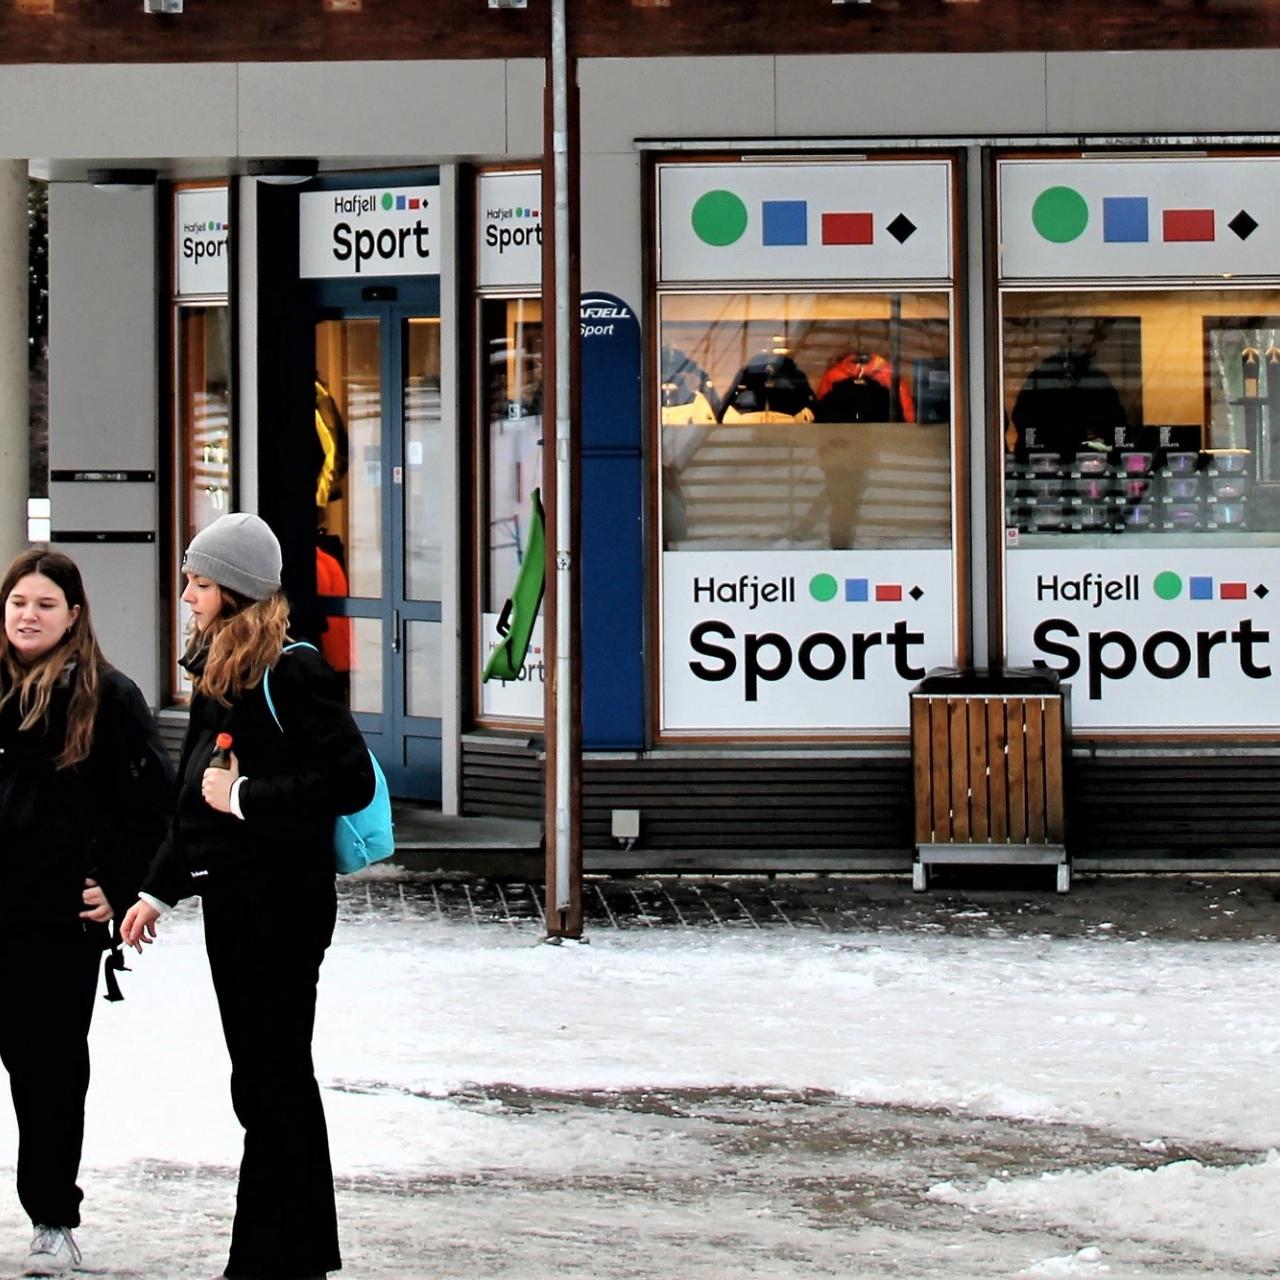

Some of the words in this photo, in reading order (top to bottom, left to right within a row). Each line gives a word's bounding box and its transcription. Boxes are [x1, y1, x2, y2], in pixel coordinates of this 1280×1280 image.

[333, 194, 377, 217] Hafjell
[486, 207, 513, 221] Hafjell
[332, 220, 430, 273] Sport
[485, 221, 544, 254] Sport
[693, 575, 795, 610] Hafjell
[1036, 573, 1139, 608] Hafjell
[688, 619, 926, 702] Sport
[1032, 617, 1272, 701] Sport
